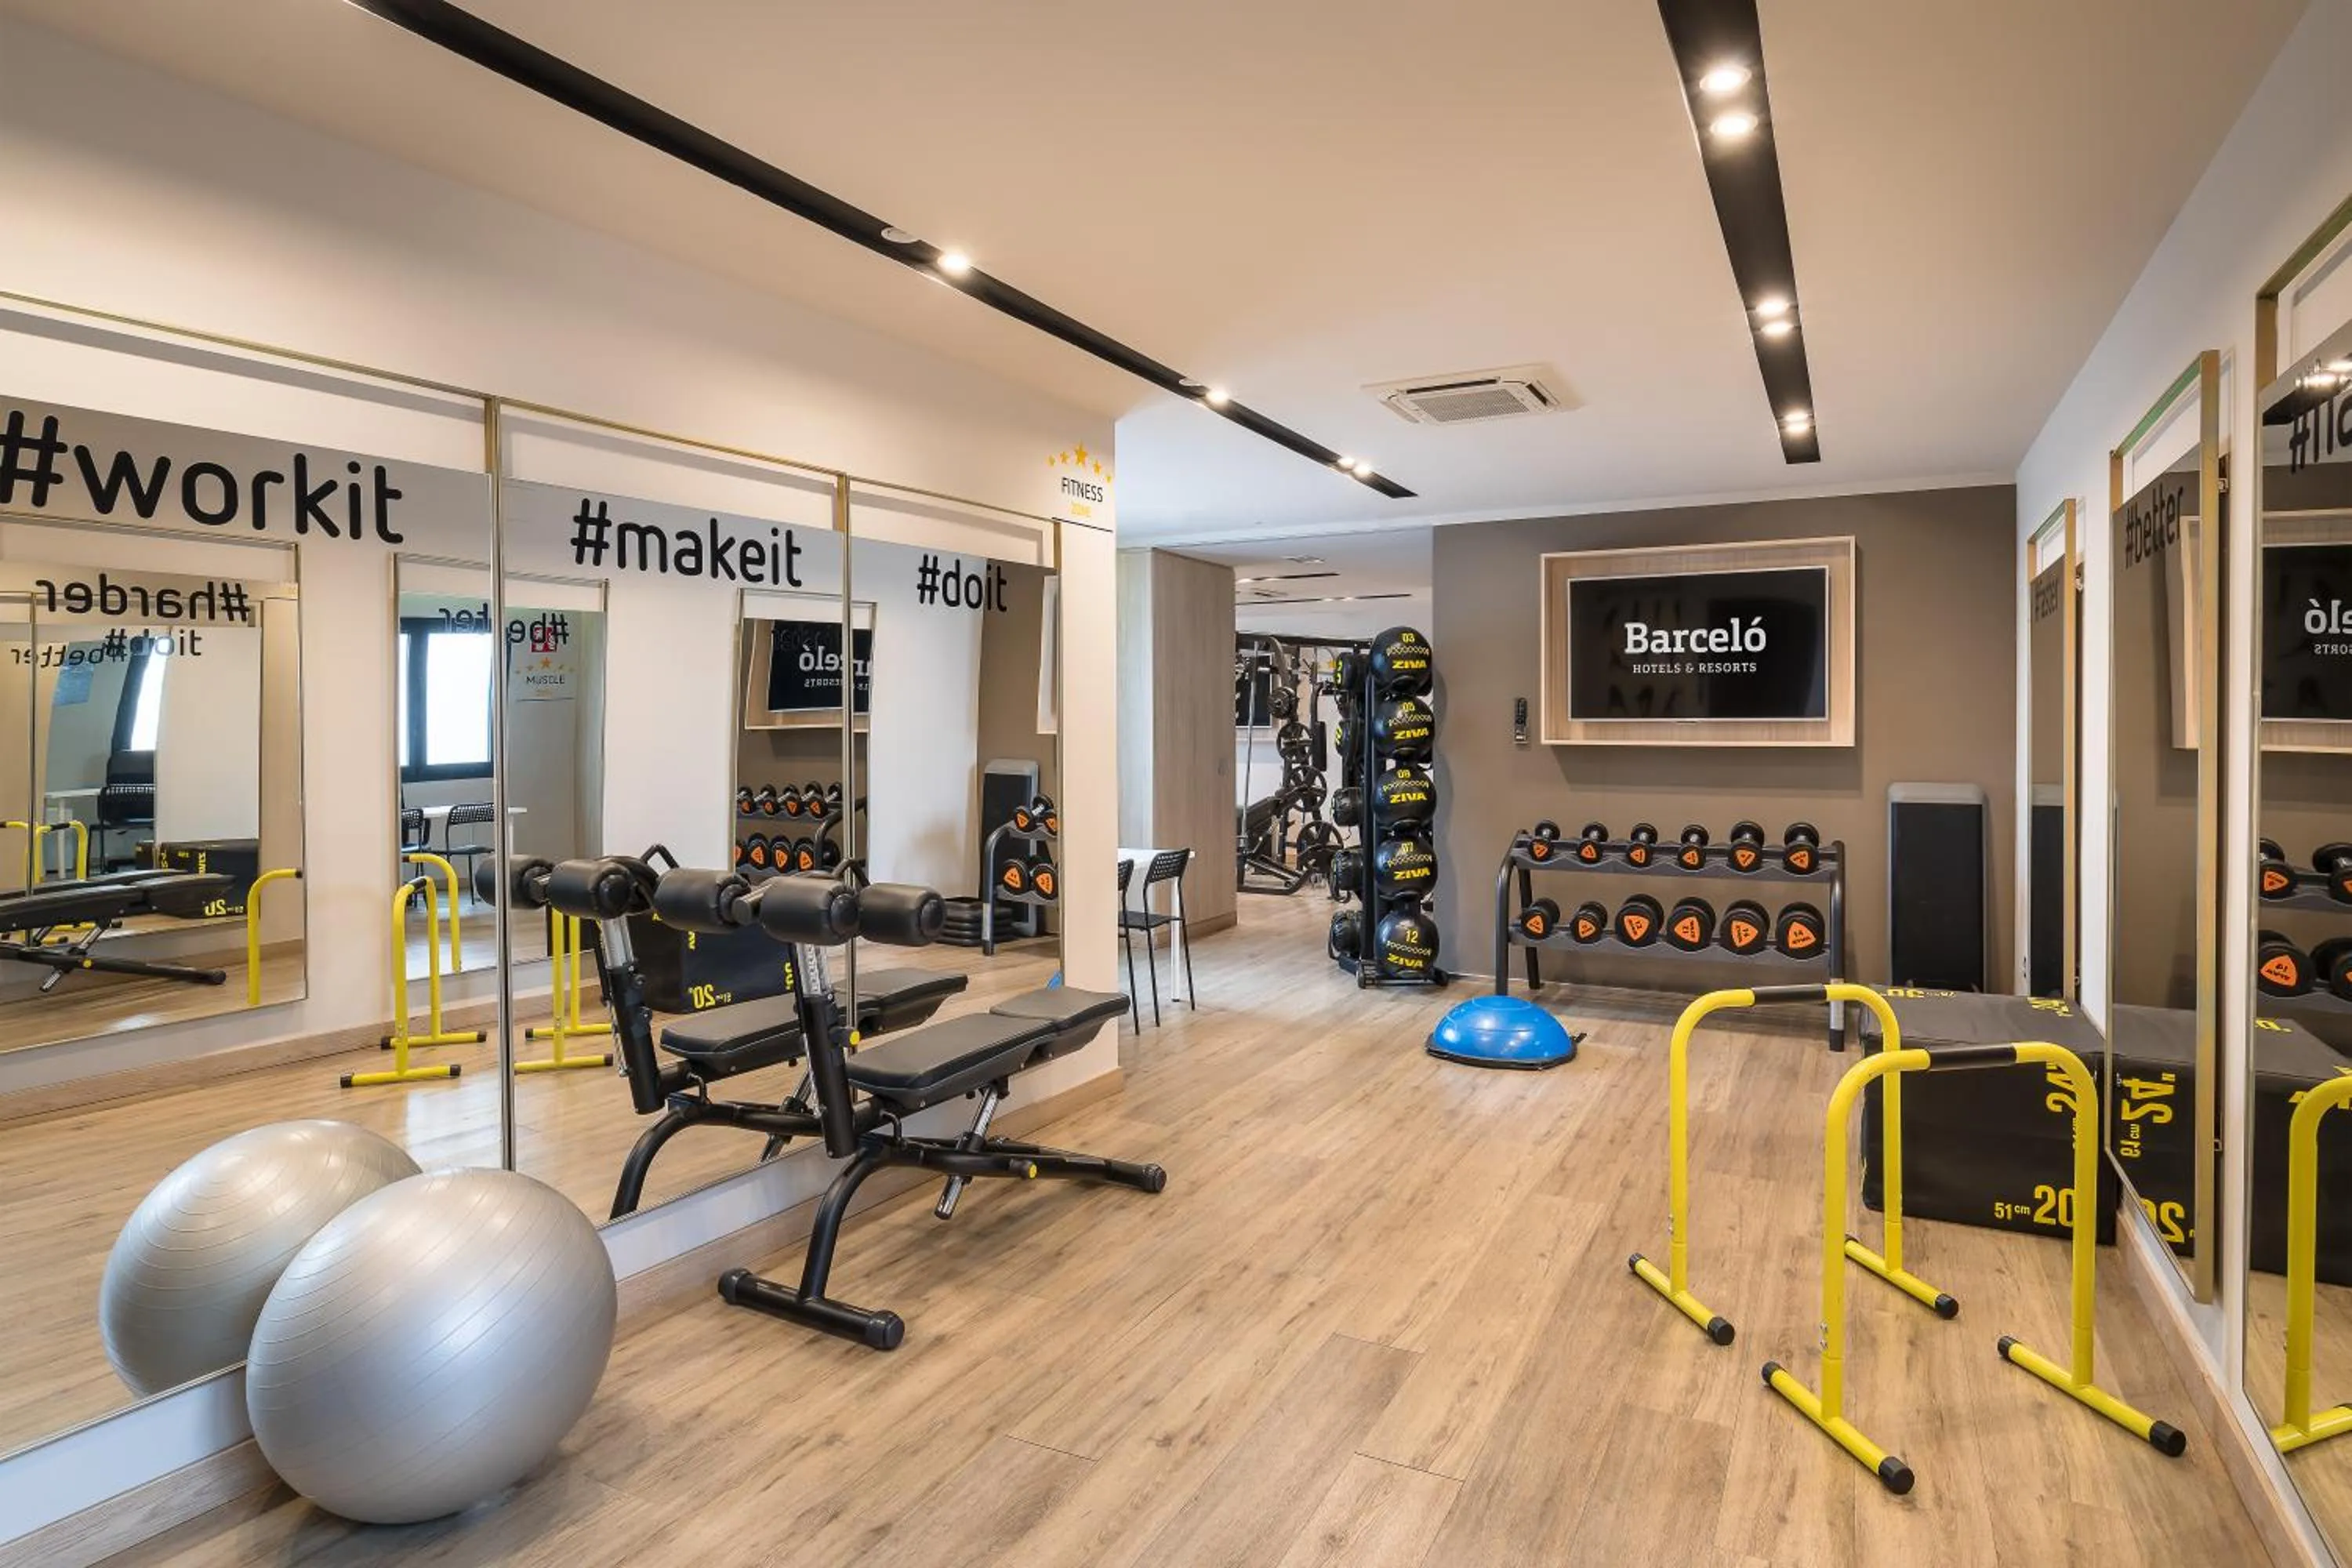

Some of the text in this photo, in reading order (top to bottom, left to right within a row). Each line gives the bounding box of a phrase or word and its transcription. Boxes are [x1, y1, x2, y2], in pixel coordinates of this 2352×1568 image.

[0, 410, 405, 544] #workit
[1062, 476, 1103, 503] FITNESS
[2125, 482, 2183, 570] #better
[571, 499, 802, 587] #makeit
[917, 554, 1007, 612] #doit
[1624, 616, 1766, 655] Barceló
[1392, 660, 1427, 669] ZIVA
[1633, 662, 1757, 674] HOTELS & RESORTS
[1393, 728, 1429, 739] ZIVA
[1390, 793, 1427, 804] ZIVA
[1394, 867, 1430, 880] ZIVA
[1406, 930, 1418, 943] 12
[1387, 953, 1423, 967] ZIVA
[1994, 1202, 2013, 1220] 51
[2014, 1203, 2031, 1215] cm
